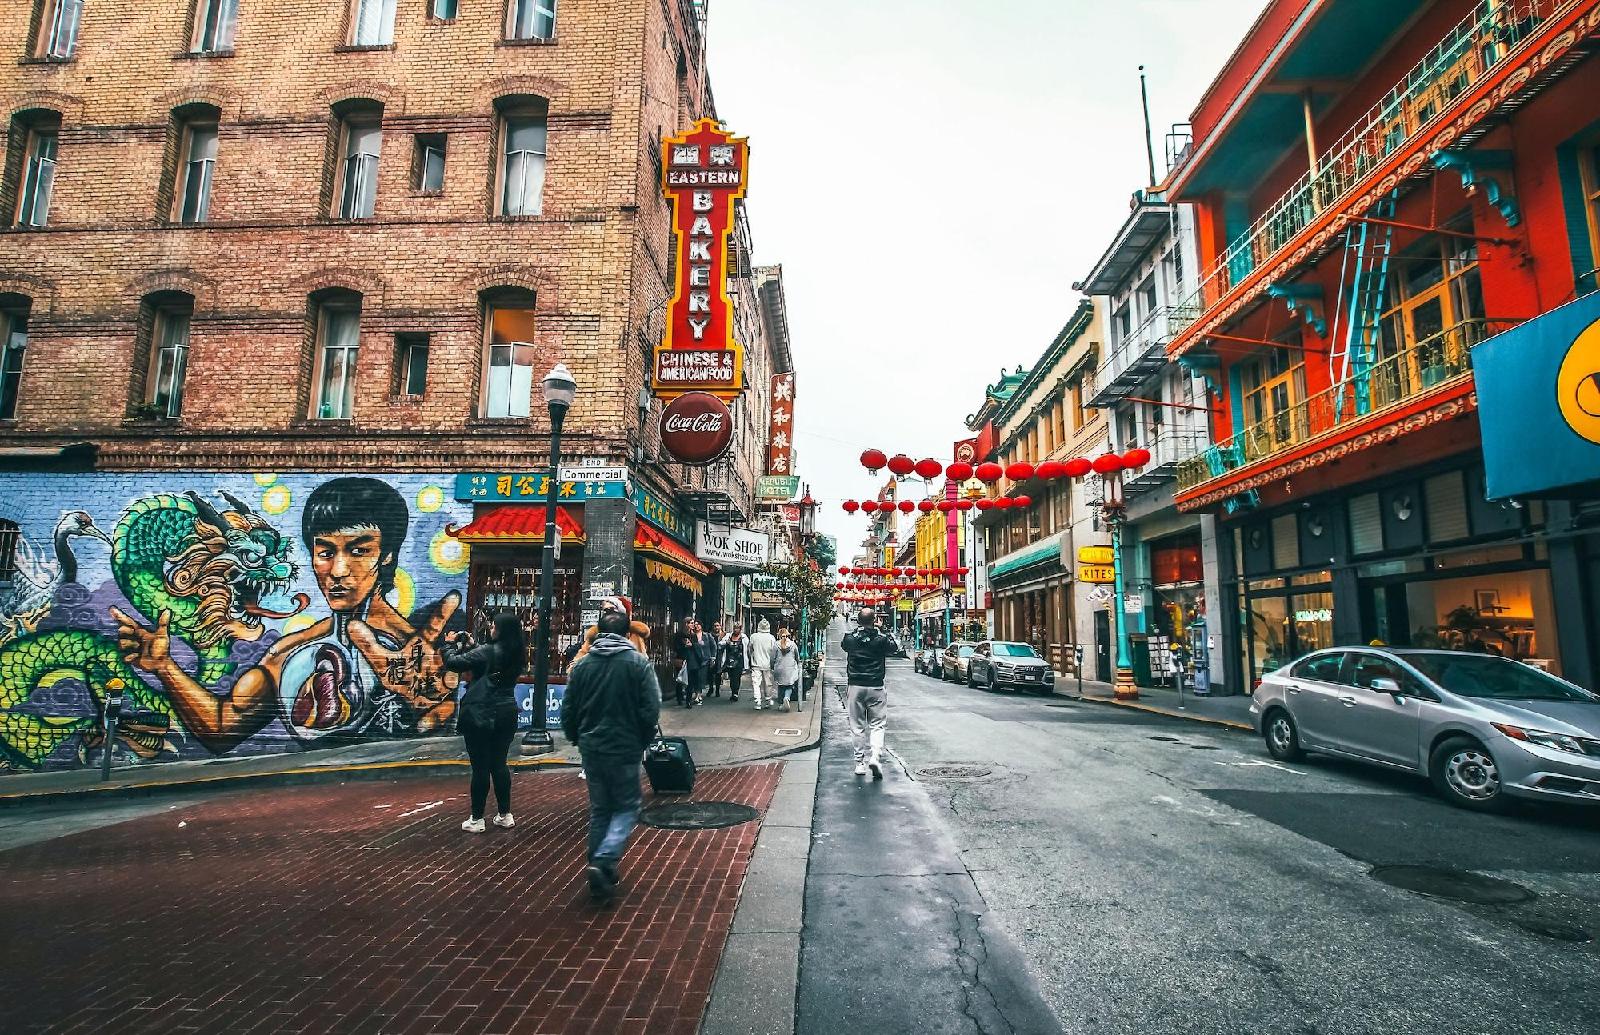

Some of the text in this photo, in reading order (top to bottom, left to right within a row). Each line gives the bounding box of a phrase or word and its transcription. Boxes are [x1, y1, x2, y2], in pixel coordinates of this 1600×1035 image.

[669, 171, 739, 183] EASTERN
[689, 190, 713, 340] BAKERY
[661, 352, 733, 366] CHINESE &
[661, 367, 733, 381] AMERICAN FOOD
[666, 413, 723, 433] Coca-Cola
[564, 470, 622, 479] Commercial
[761, 486, 791, 495] HOTEL
[703, 533, 730, 550] WOK
[734, 539, 763, 555] SHOP
[704, 548, 763, 562] www.wokshop.com
[1084, 569, 1112, 578] KITES
